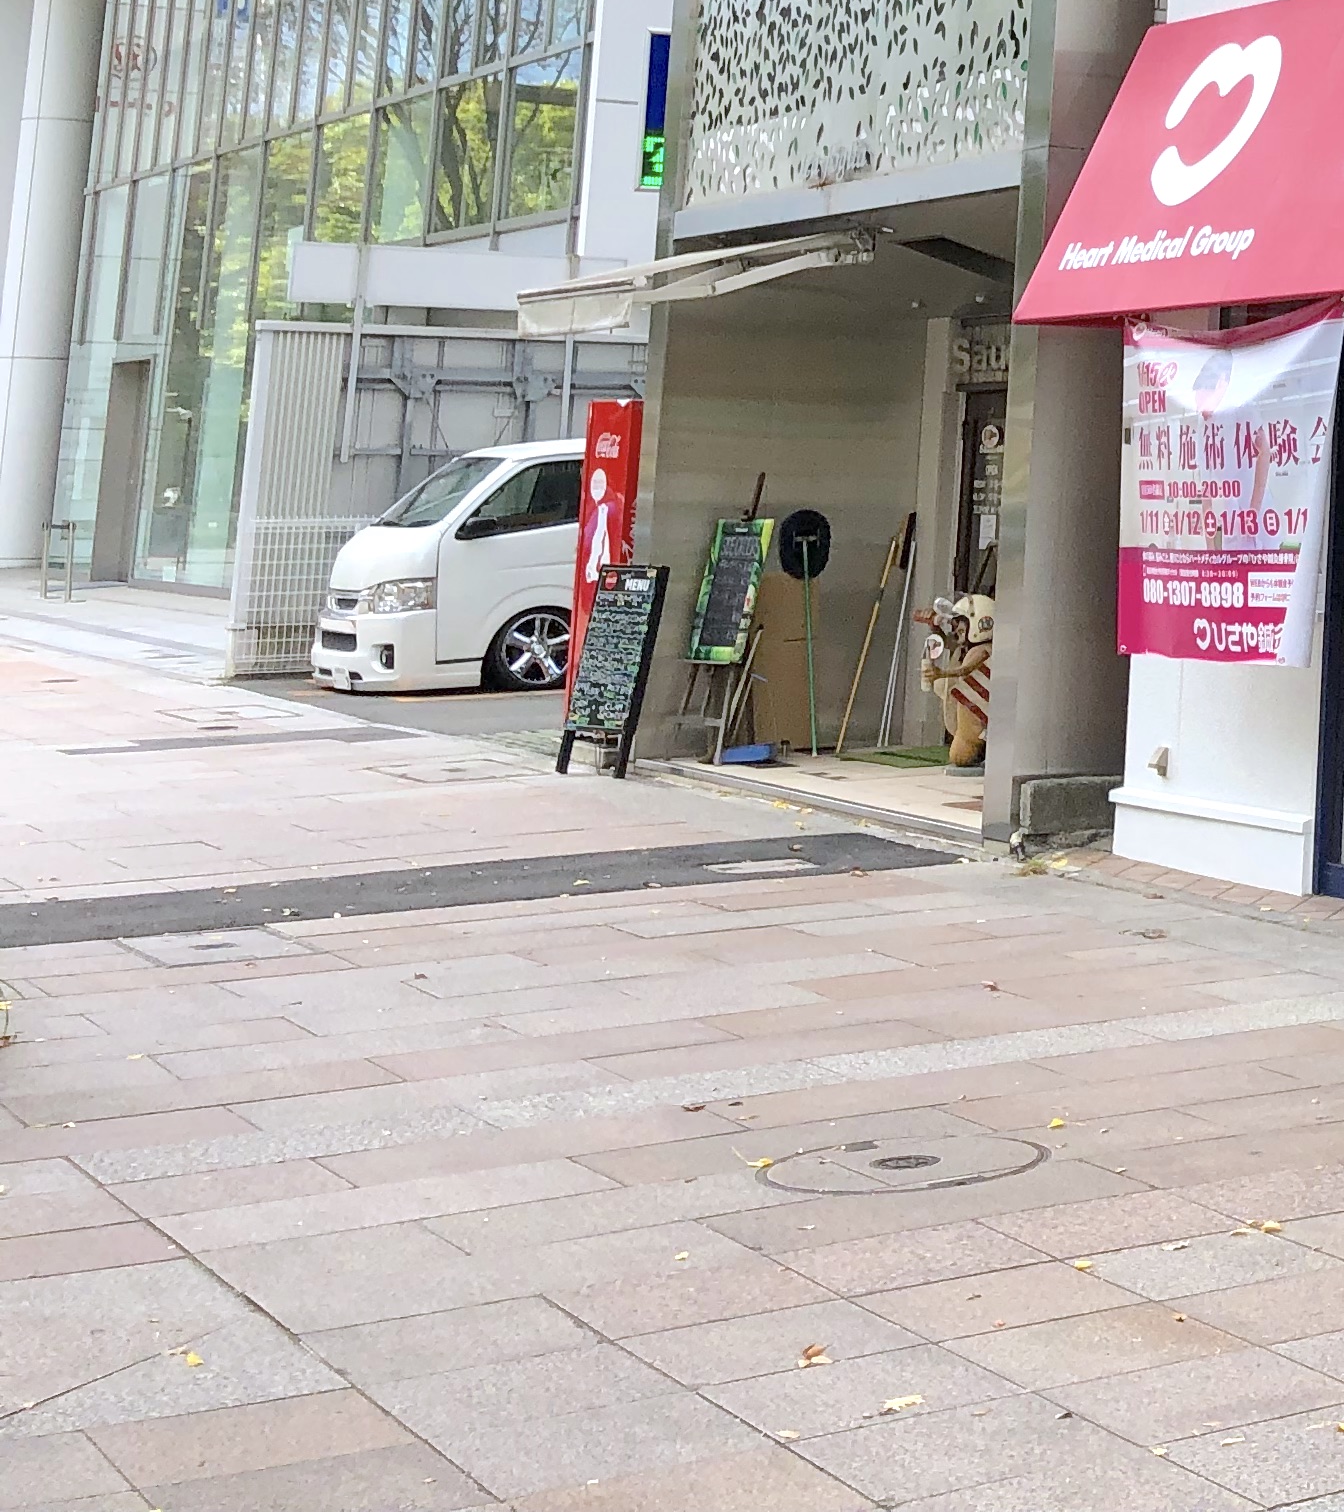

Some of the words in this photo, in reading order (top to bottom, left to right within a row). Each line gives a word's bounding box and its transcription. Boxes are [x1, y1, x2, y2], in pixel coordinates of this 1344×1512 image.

[1058, 240, 1115, 271] Heart
[1111, 225, 1194, 265] Medical
[1190, 224, 1255, 260] Group
[953, 338, 1008, 372] Sau
[1138, 389, 1167, 414] OPEN
[1138, 416, 1328, 471] 無料施術体験会
[1167, 479, 1241, 499] 10:00-20:00
[624, 578, 651, 592] MENU
[1143, 578, 1245, 608] 080-1307-8898
